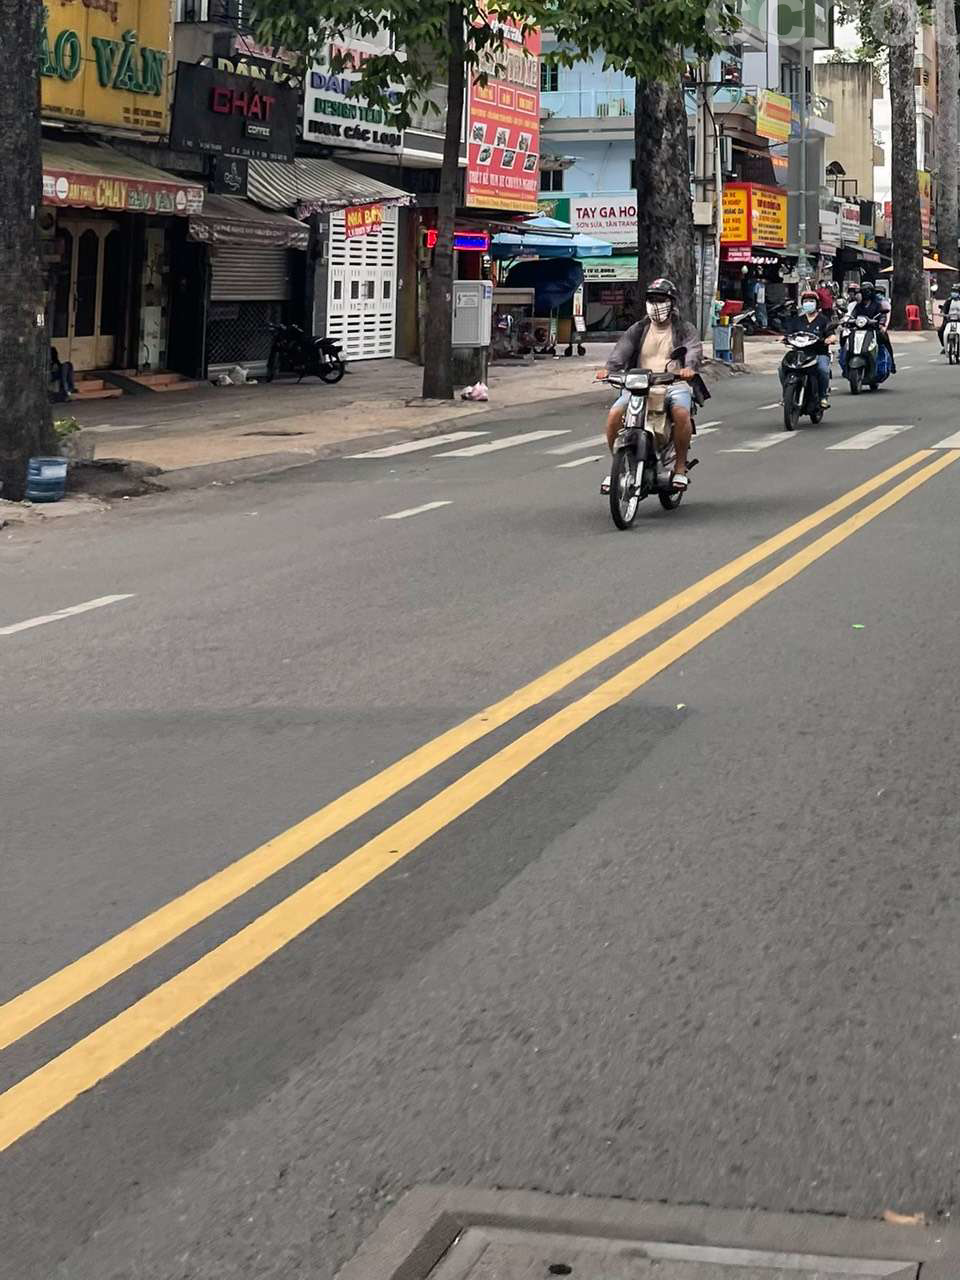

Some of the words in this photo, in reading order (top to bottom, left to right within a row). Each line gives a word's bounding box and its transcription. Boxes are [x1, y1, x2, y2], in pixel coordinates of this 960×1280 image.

[247, 125, 270, 136] COFFEE
[343, 124, 371, 142] CÁC
[96, 178, 128, 209] CHAY
[575, 207, 597, 219] TAY
[599, 206, 616, 218] GA
[618, 205, 638, 217] HO
